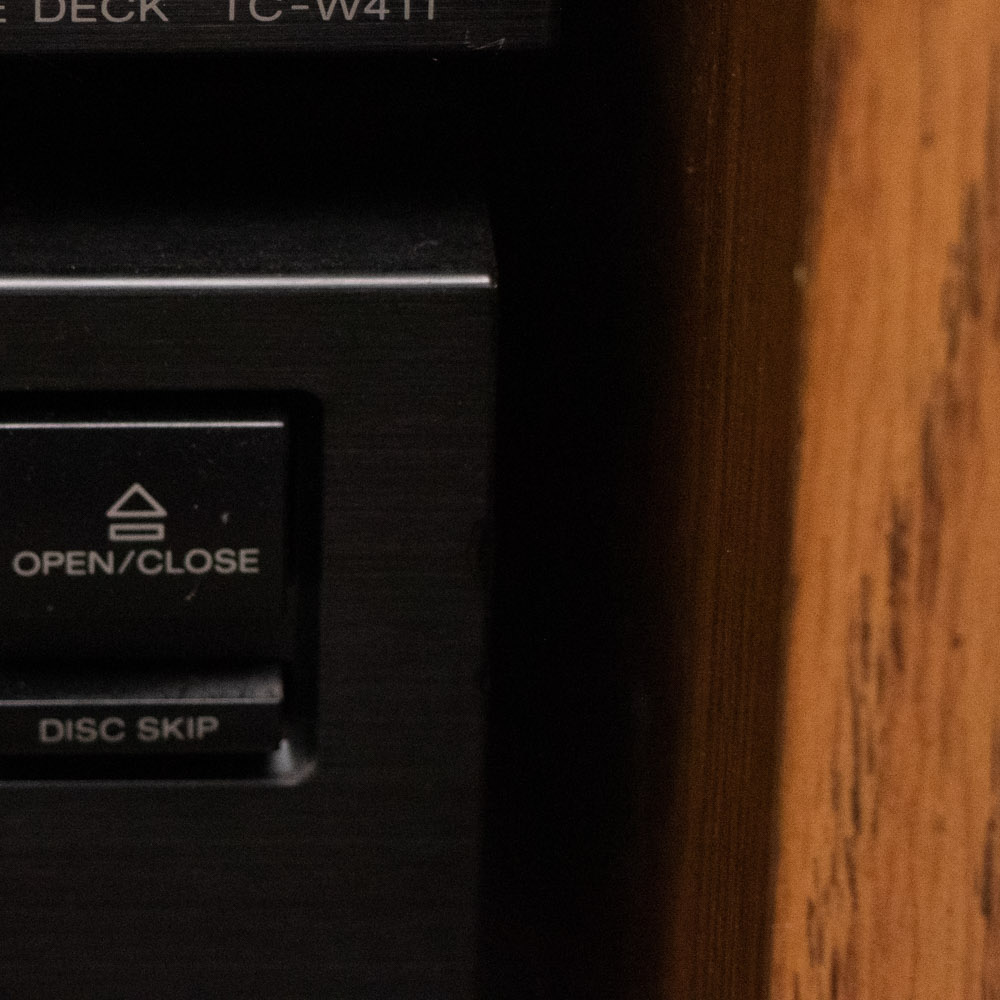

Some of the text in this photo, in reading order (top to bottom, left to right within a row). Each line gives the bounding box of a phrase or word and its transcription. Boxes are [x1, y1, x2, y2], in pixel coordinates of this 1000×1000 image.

[12, 548, 260, 577] OPEN/CLOSE
[39, 715, 220, 743] DISC SKIP
